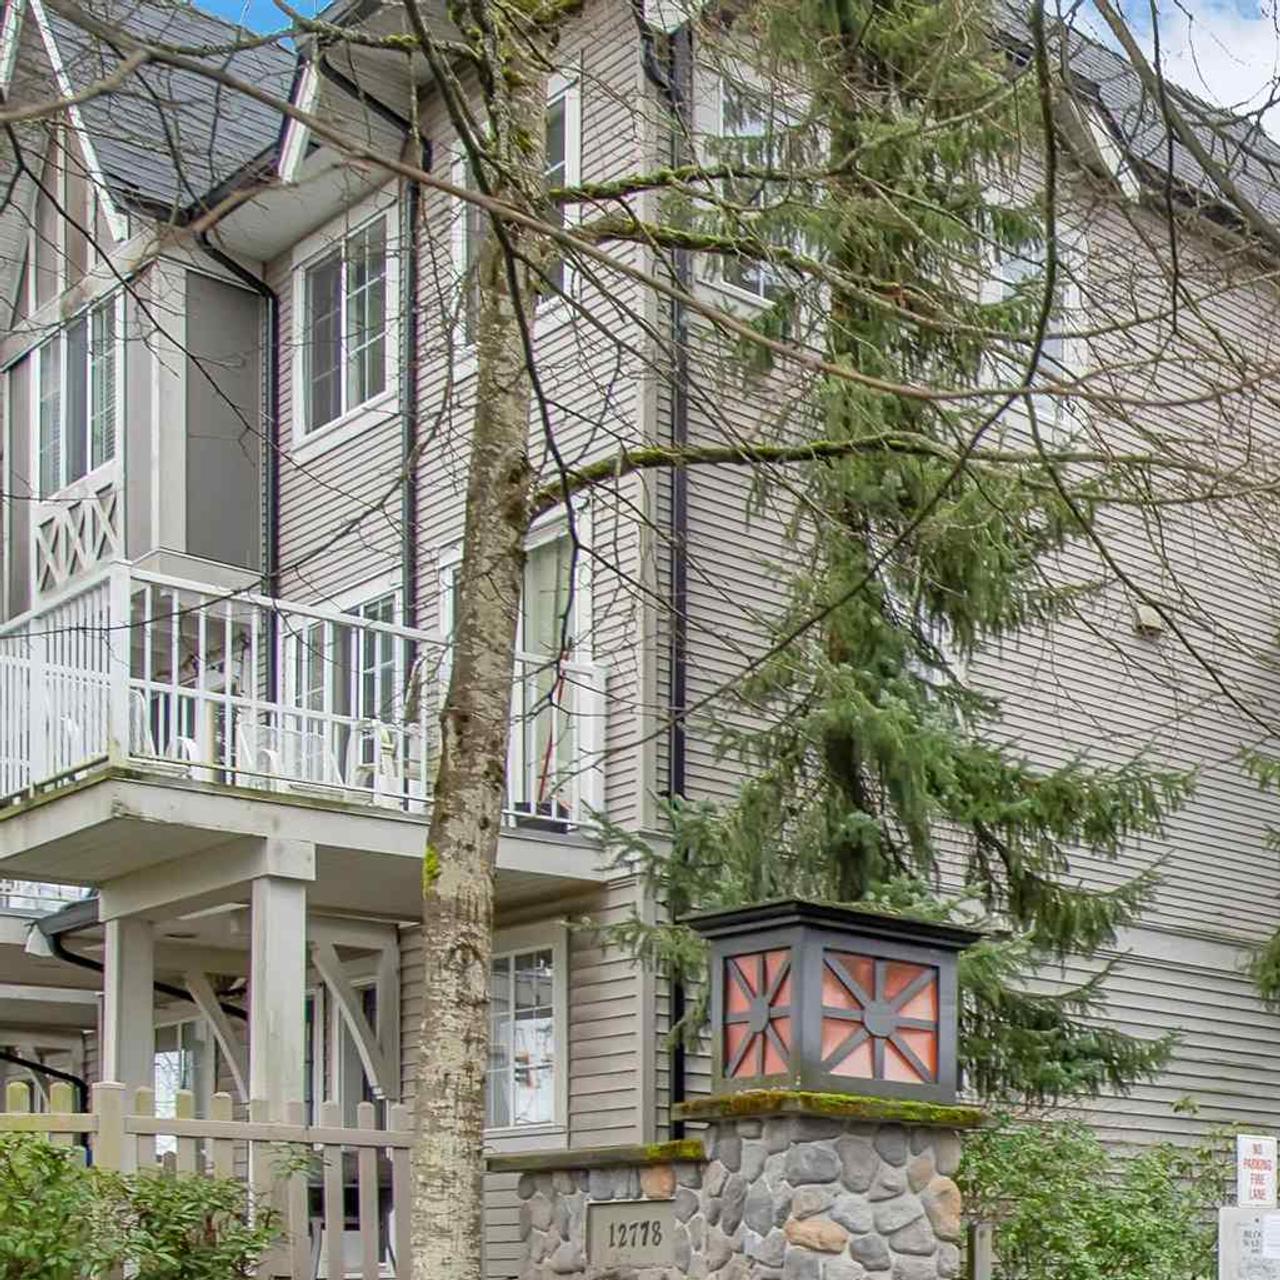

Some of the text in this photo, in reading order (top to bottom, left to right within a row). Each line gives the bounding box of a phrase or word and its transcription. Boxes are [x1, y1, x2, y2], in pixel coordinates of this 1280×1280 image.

[1242, 1158, 1273, 1172] PARKING
[1250, 1173, 1266, 1185] FIRE
[1249, 1188, 1268, 1201] LANE
[608, 1220, 662, 1248] 12778
